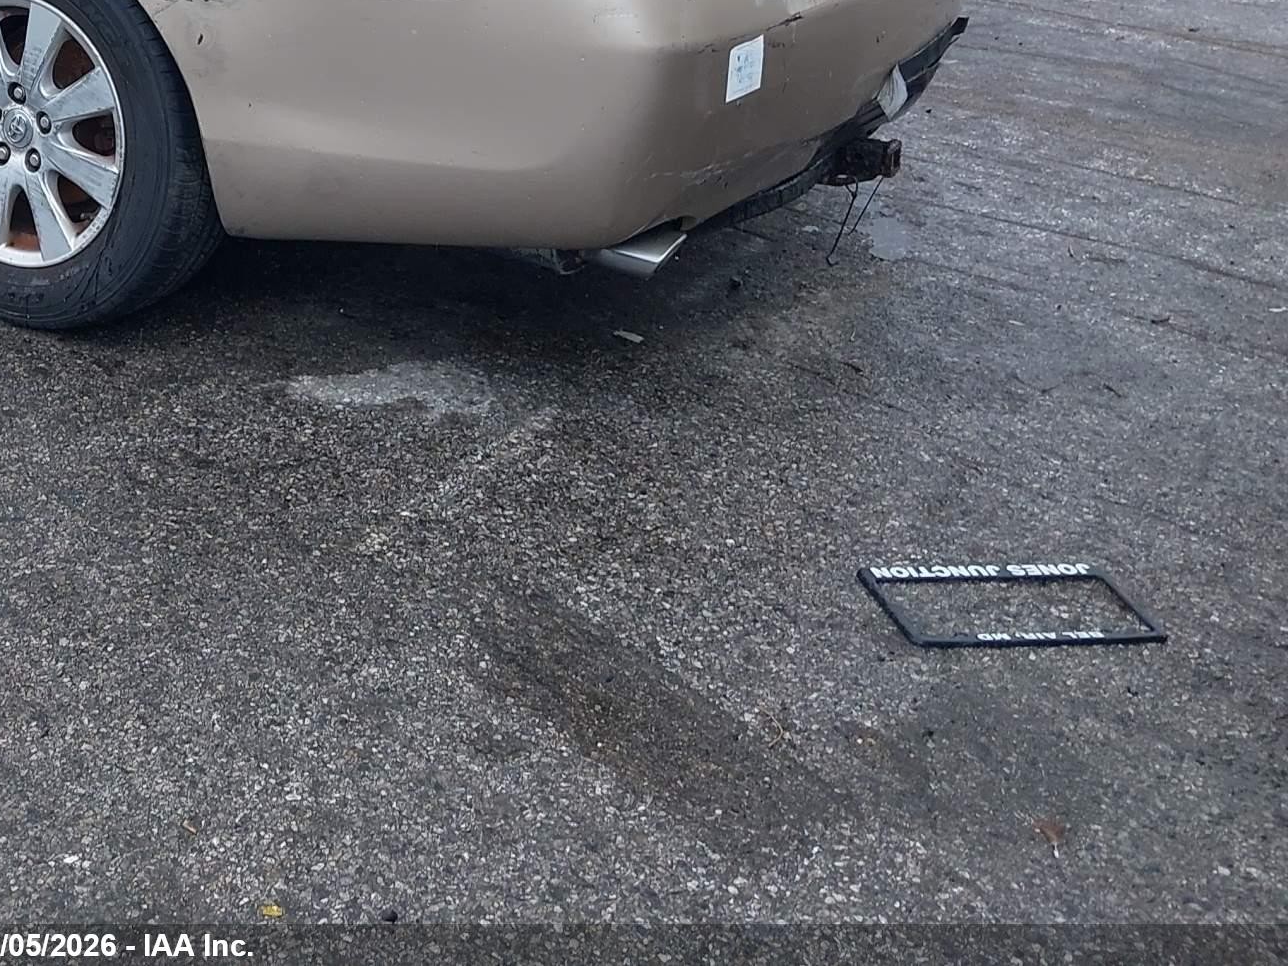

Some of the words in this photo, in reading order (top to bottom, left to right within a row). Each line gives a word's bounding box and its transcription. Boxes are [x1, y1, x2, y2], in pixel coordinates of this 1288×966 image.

[870, 565, 1000, 578] JUNCTION
[1006, 564, 1090, 576] JONES
[976, 633, 1011, 641] MD
[1062, 631, 1105, 639] BEL
